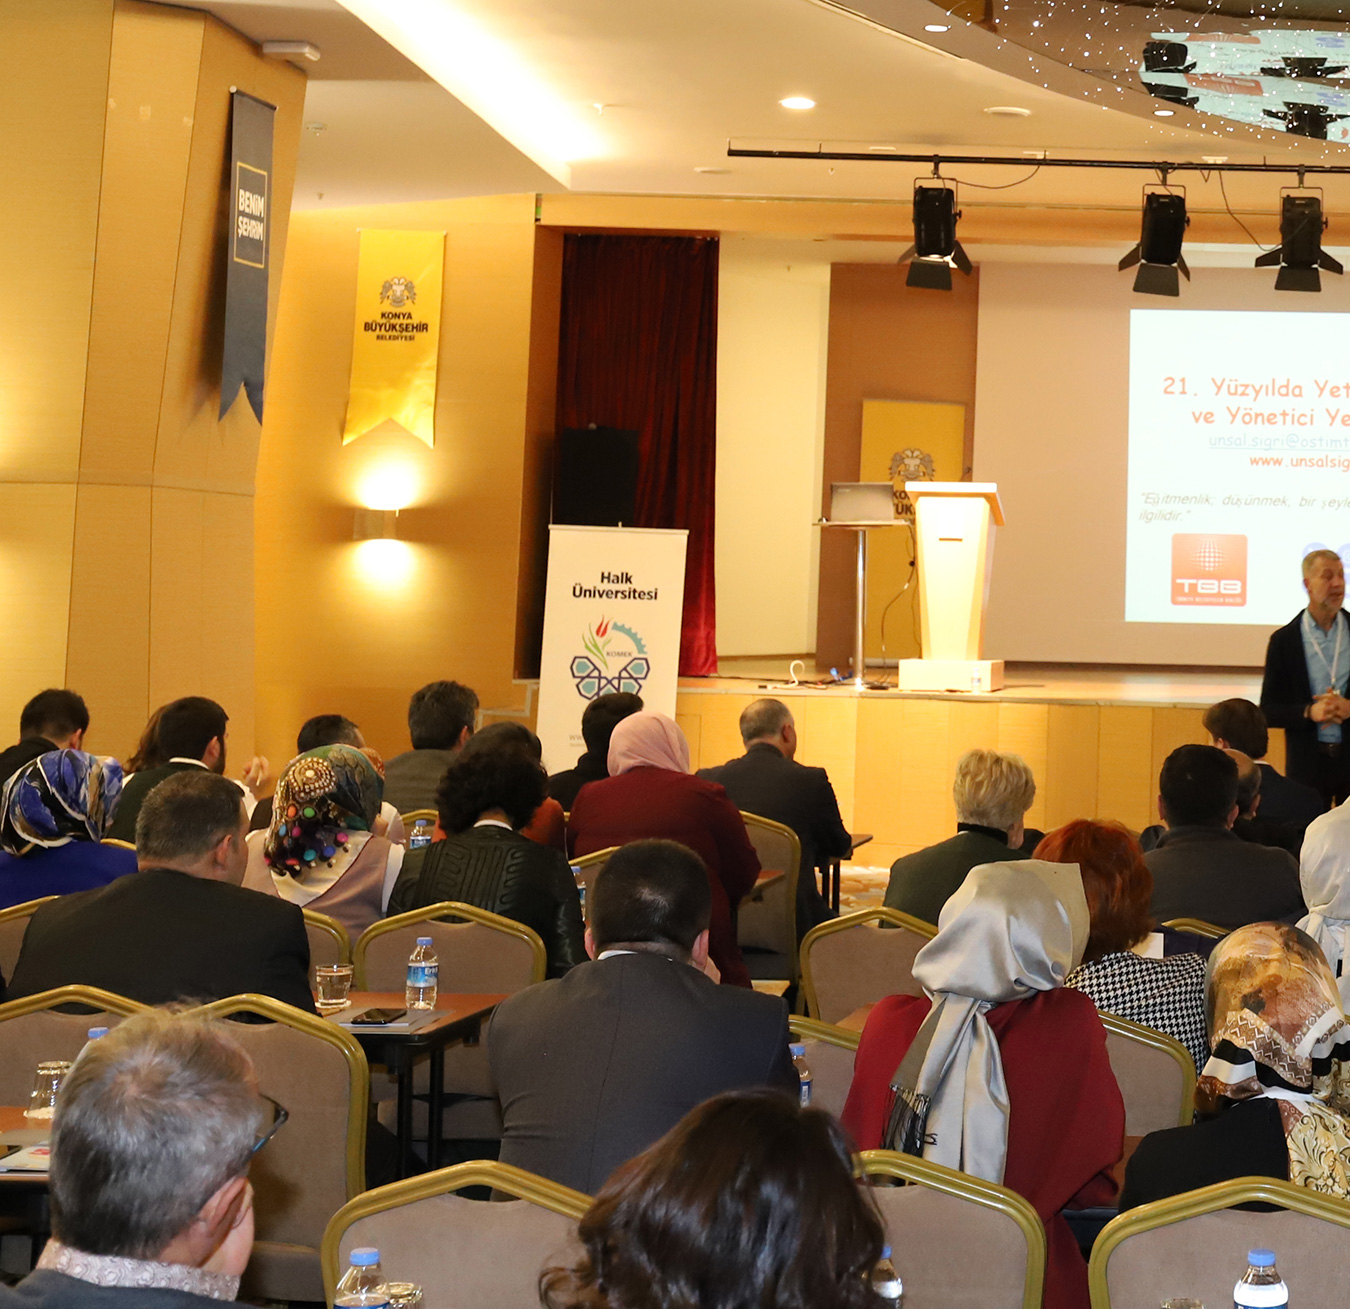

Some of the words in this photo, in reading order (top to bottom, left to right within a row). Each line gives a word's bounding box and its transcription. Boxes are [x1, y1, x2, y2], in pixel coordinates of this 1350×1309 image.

[239, 189, 264, 218] BENİM
[238, 216, 263, 241] ŞEHRİM
[381, 311, 413, 320] KONYA
[364, 319, 429, 334] BÜYÜKŞEHİR
[1163, 377, 1199, 397] 21.
[1212, 377, 1304, 402] Yüzyılda
[1192, 410, 1215, 424] ve
[1226, 406, 1315, 427] Yönetici
[1299, 495, 1316, 508] bir
[600, 571, 633, 584] Halk
[572, 583, 658, 600] Üniversitesi
[1176, 578, 1242, 595] TBB
